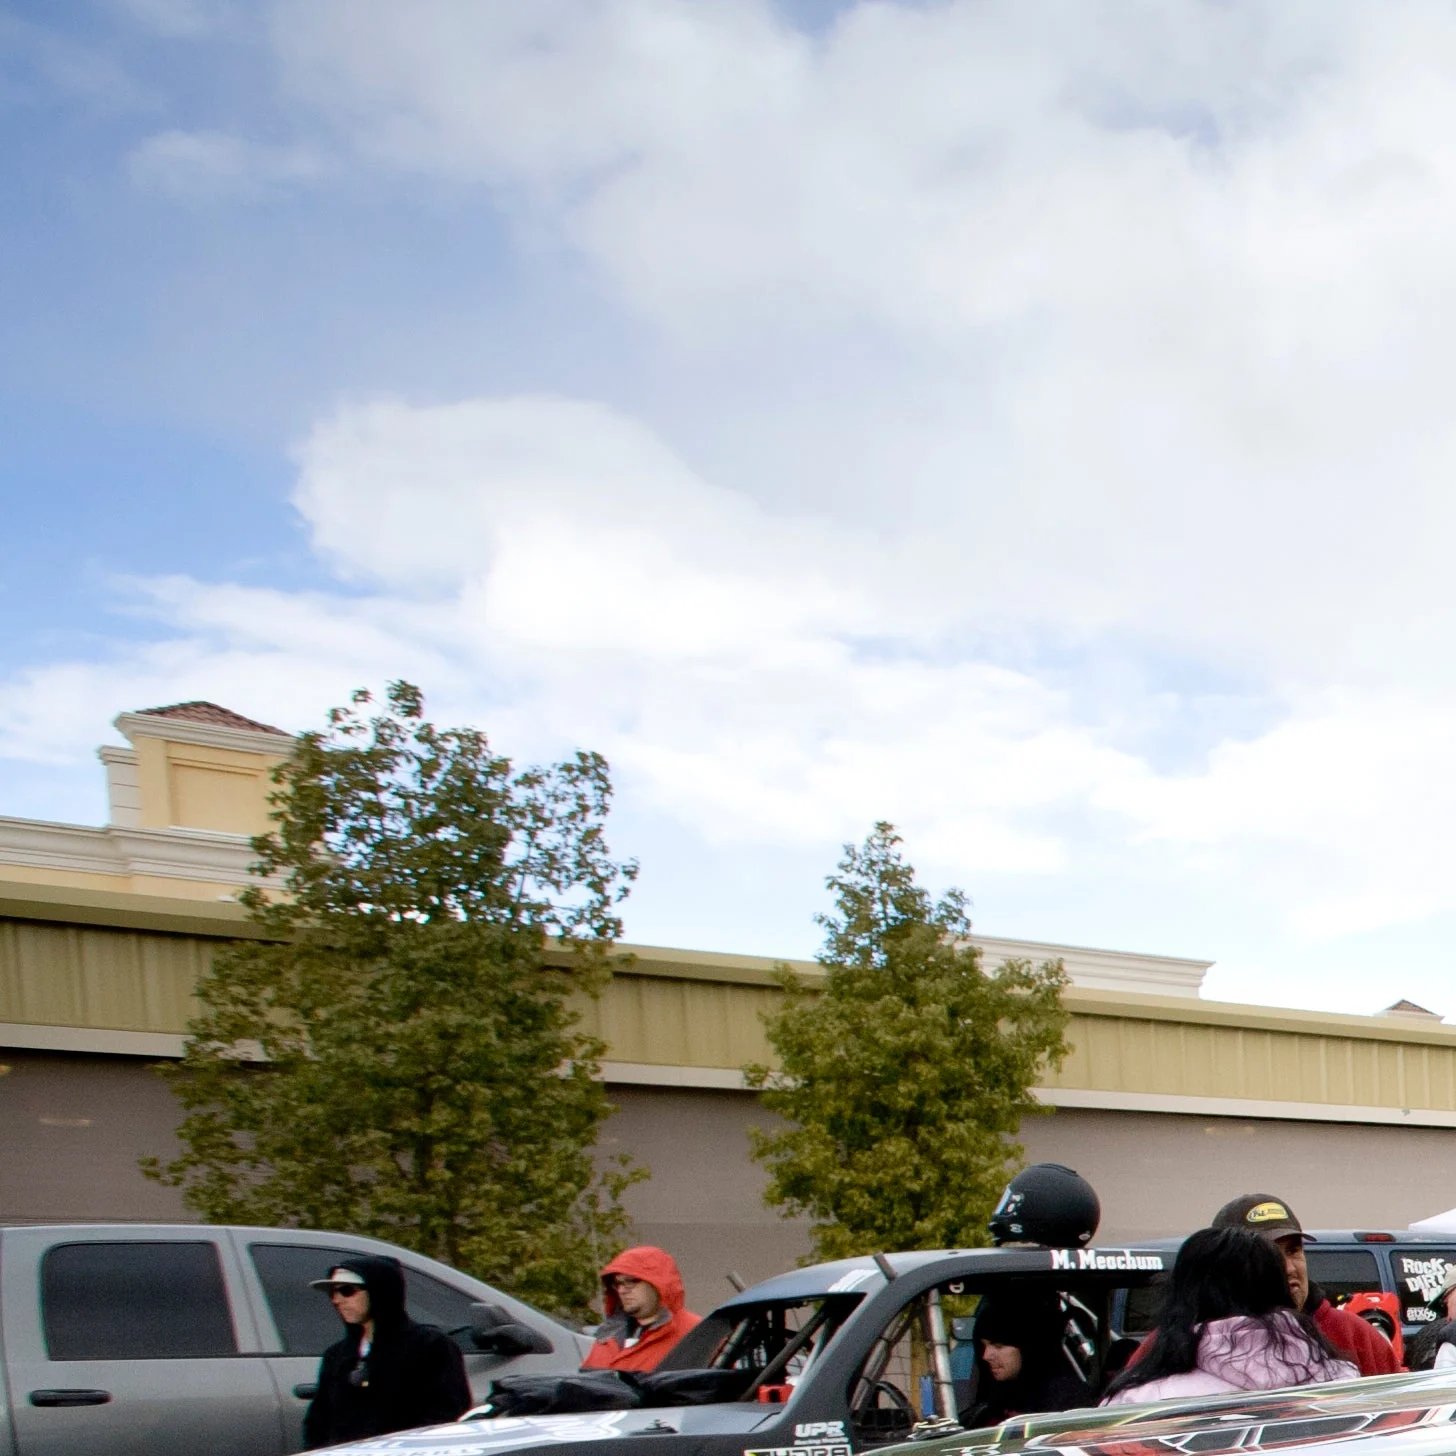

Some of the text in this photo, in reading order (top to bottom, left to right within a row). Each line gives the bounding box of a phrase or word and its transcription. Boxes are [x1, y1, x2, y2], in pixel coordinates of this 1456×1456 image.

[1051, 1249, 1164, 1271] M. Meachum
[1402, 1258, 1446, 1274] ROCK
[1405, 1273, 1445, 1293] DIRT
[795, 1421, 844, 1438] UPR
